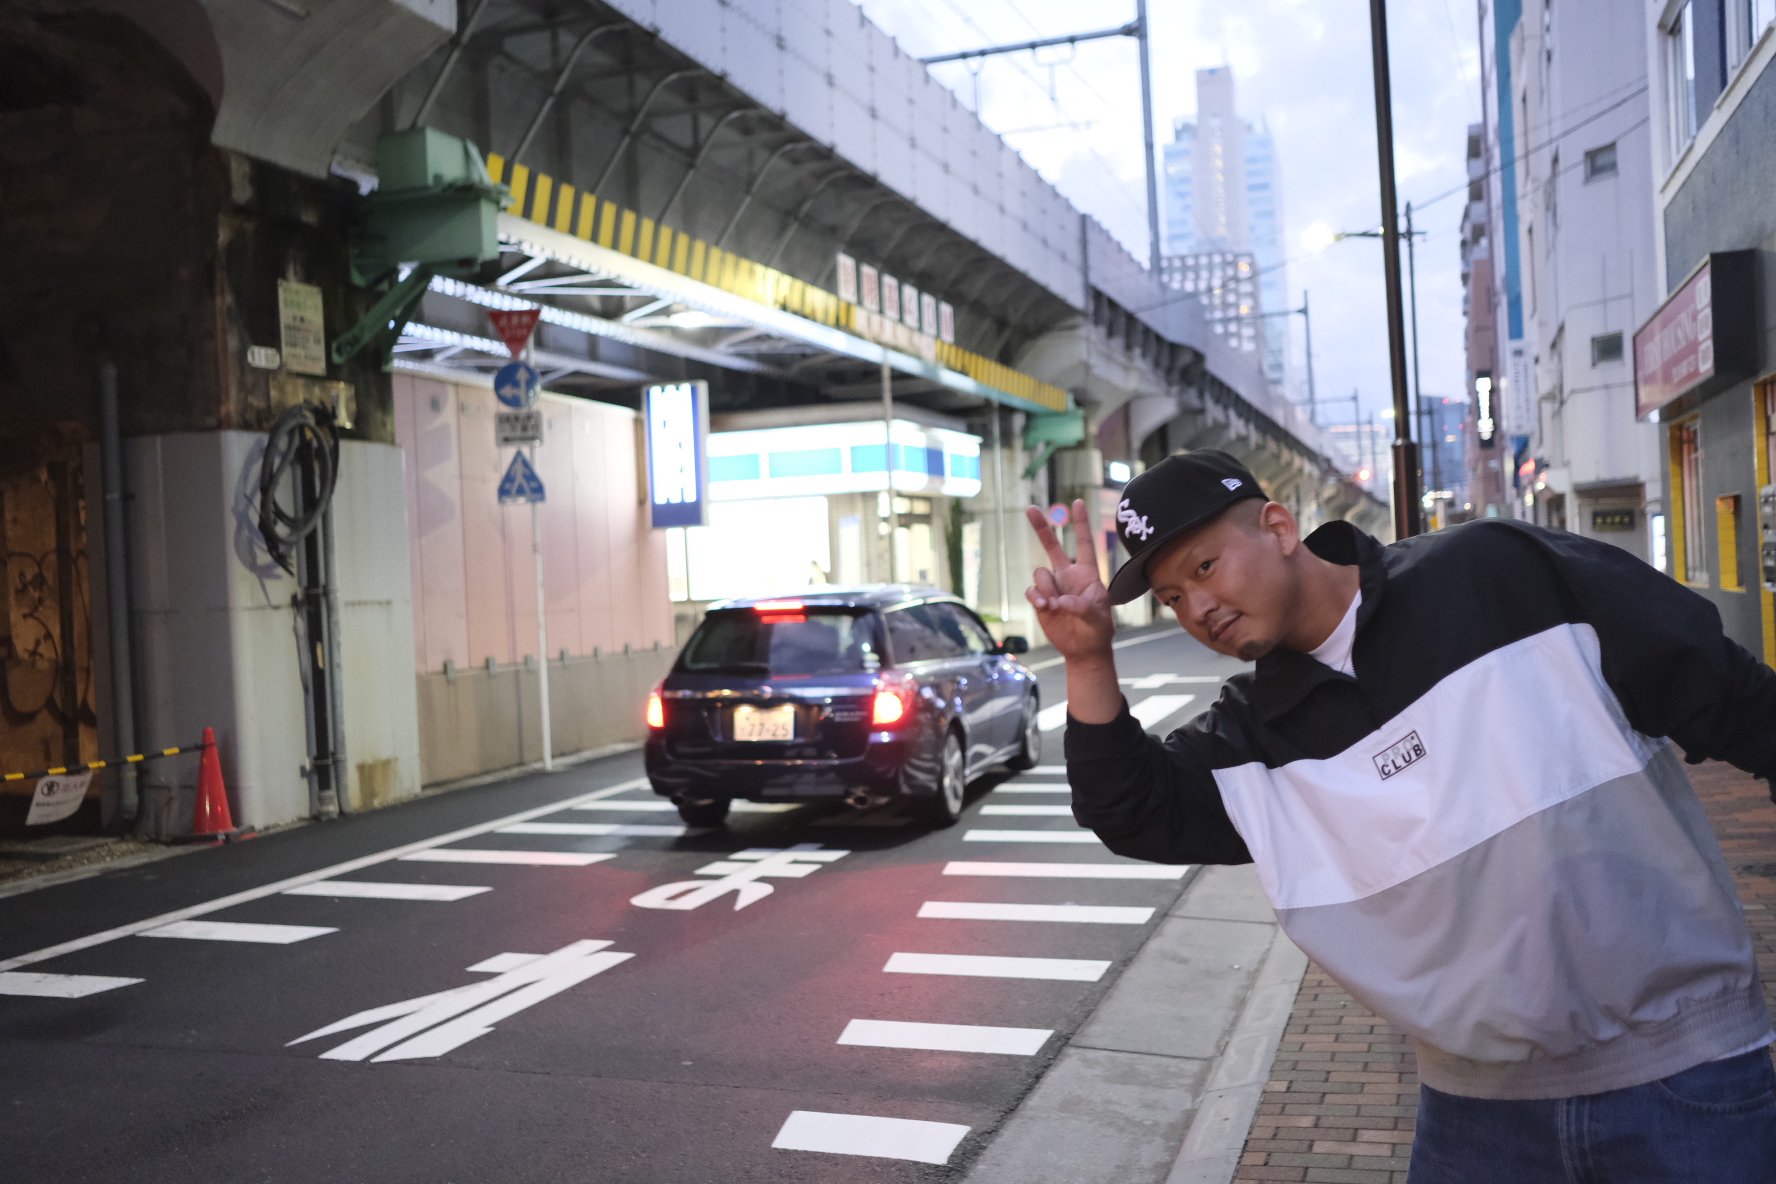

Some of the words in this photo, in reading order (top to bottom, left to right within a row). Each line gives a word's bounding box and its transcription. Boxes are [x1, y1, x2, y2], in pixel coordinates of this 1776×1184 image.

[1117, 498, 1154, 541] Sox
[1381, 738, 1412, 764] PRO
[1381, 743, 1423, 776] CLUB
